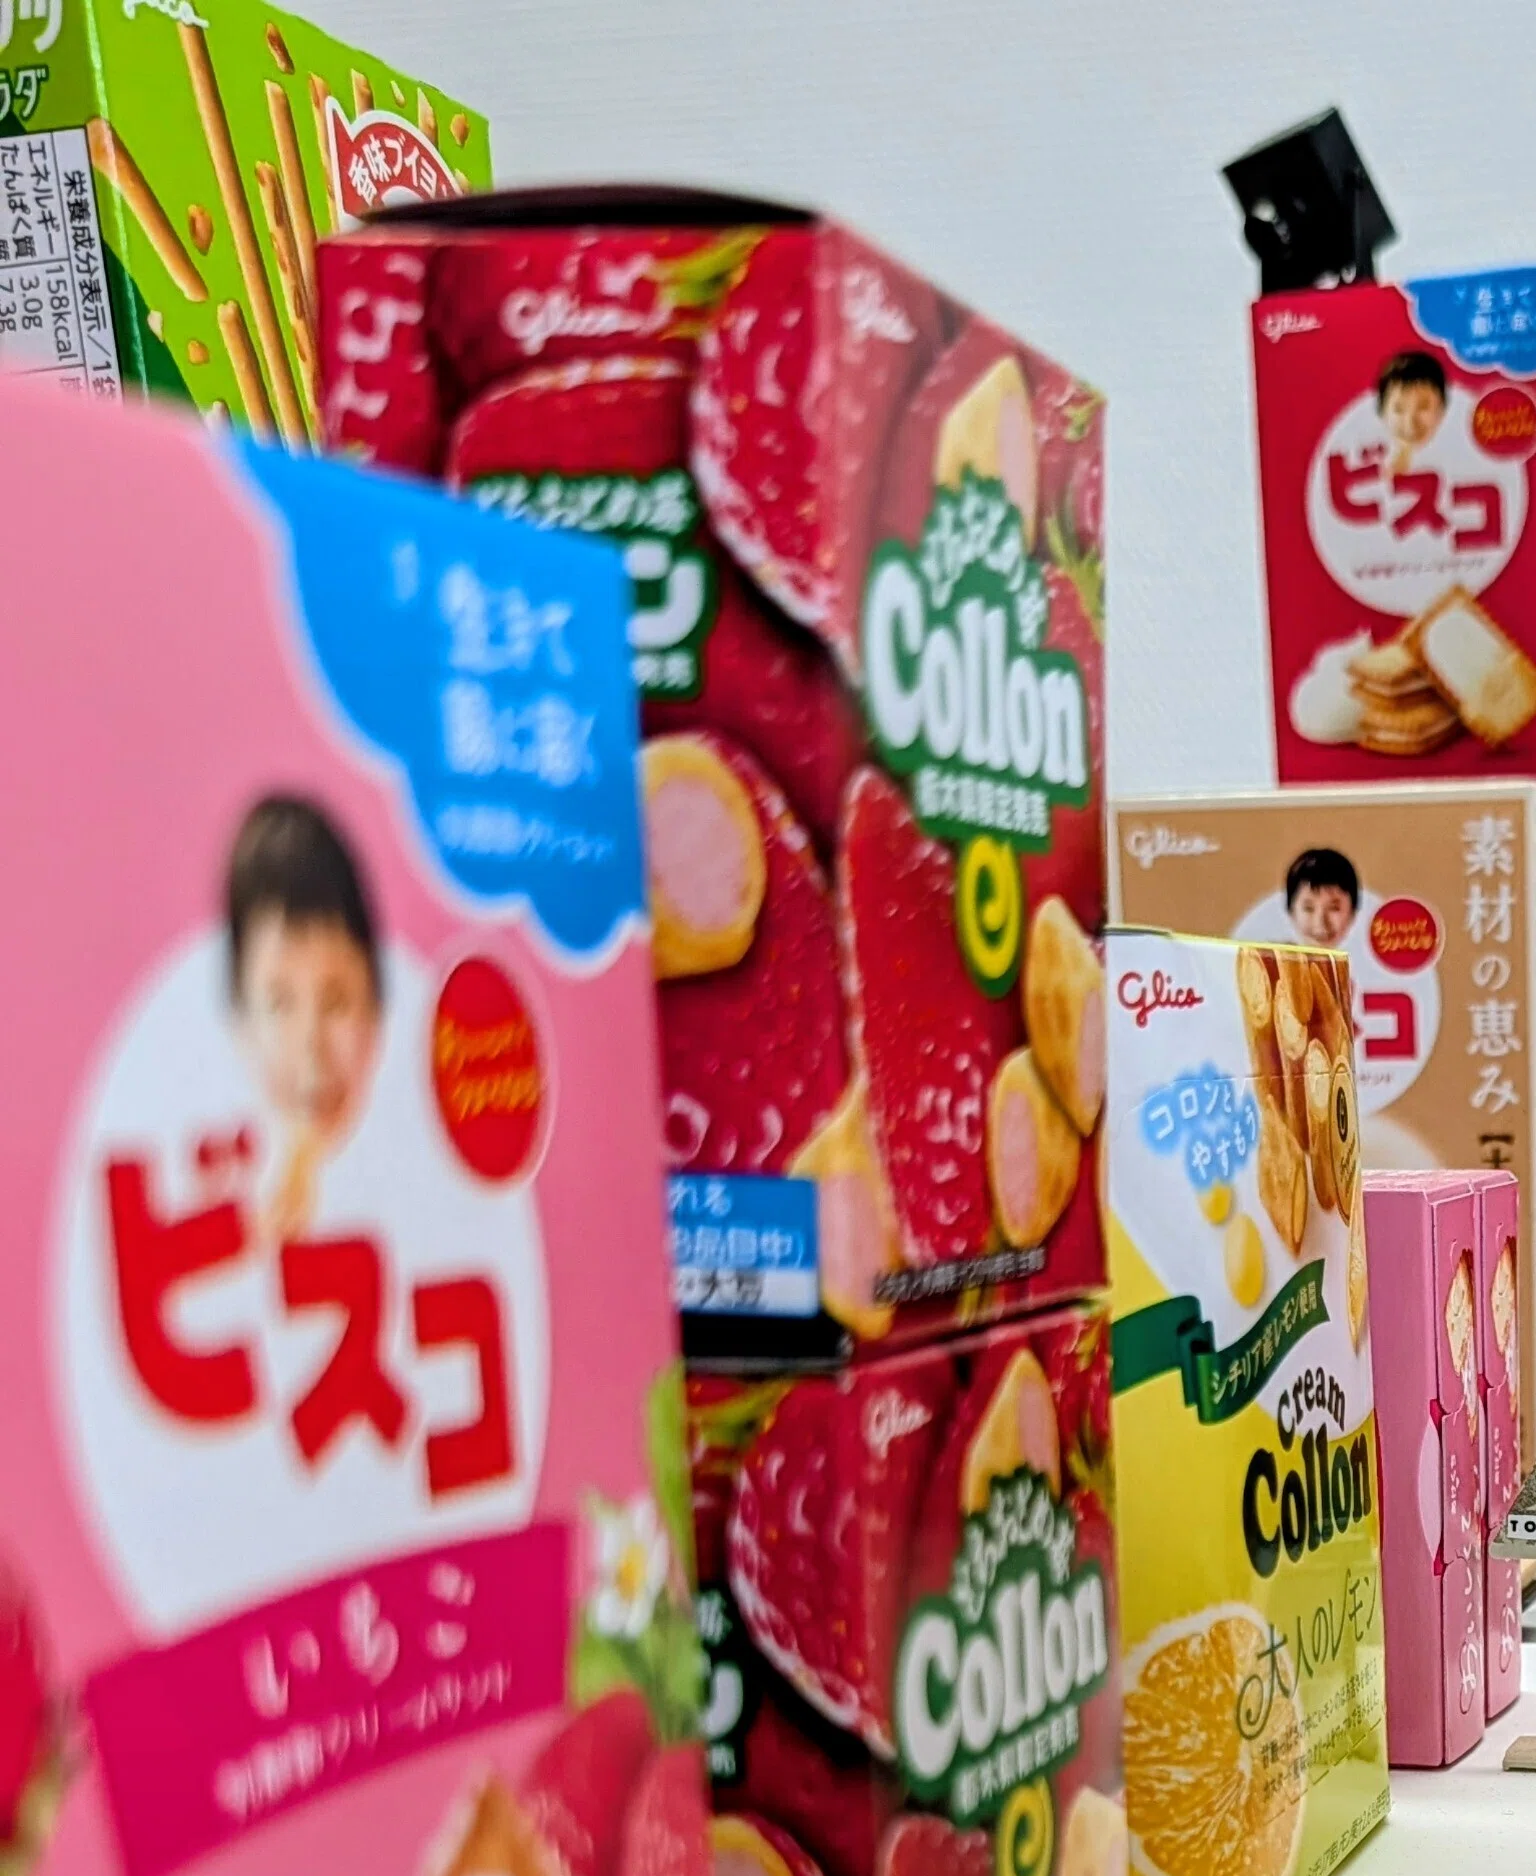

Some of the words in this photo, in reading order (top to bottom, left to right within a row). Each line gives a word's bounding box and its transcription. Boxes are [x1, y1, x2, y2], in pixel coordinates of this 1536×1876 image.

[0, 143, 37, 260] たんぱく質
[27, 141, 61, 255] エネルギー
[348, 132, 447, 207] 香味ブイヨ
[20, 276, 43, 331] 3.0g
[46, 265, 79, 363] 158kcal
[1328, 444, 1501, 550] ビスコ
[866, 557, 1088, 788] Collon
[1126, 827, 1220, 869] Glico
[1117, 970, 1204, 1029] Glico
[1461, 813, 1521, 1115] 素材の恵み
[1149, 1083, 1232, 1141] コロンと
[105, 1128, 518, 1500] ビスコ
[1242, 1422, 1372, 1579] Collon
[900, 1573, 1108, 1779] Collon
[1236, 1567, 1377, 1741] 大人のレモン
